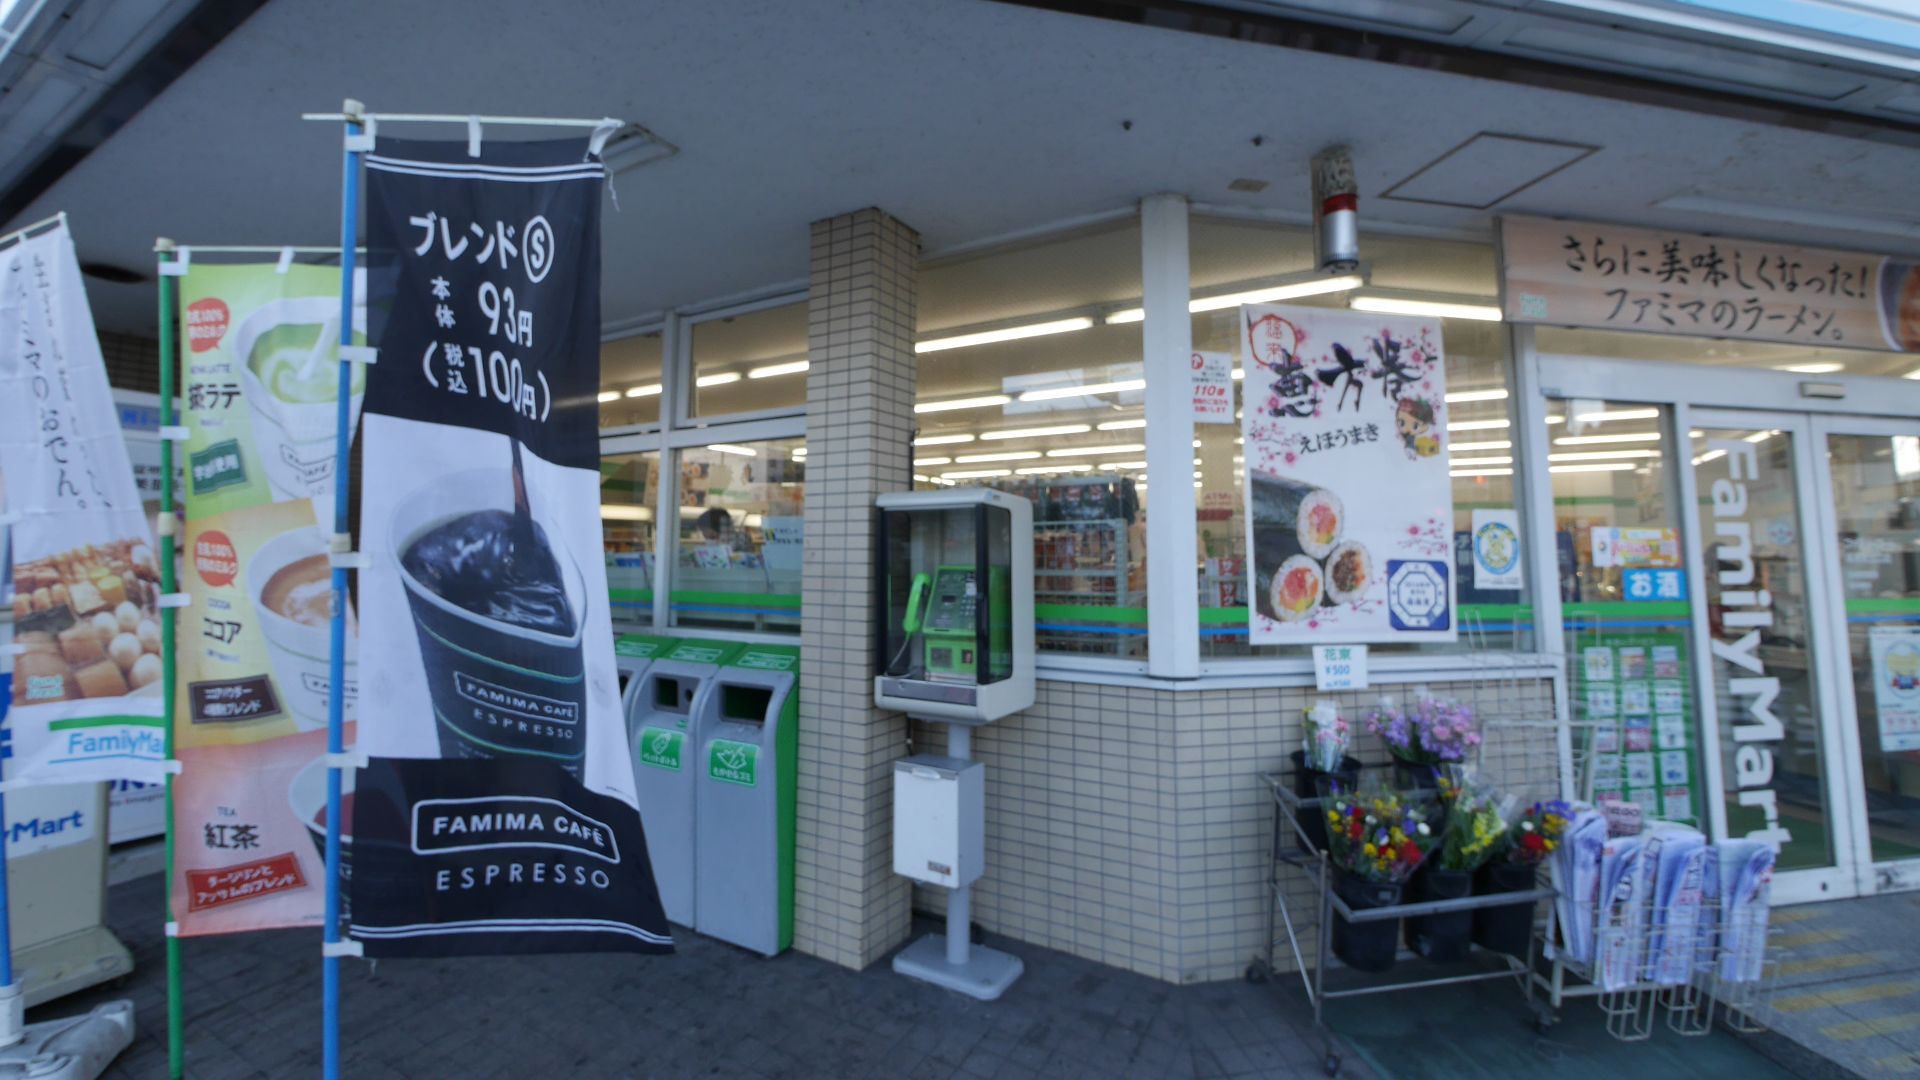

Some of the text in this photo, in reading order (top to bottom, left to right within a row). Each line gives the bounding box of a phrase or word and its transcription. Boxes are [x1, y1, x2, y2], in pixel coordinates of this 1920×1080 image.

[408, 212, 519, 270] ブレンド
[1562, 235, 1869, 299] さらに美味しくなった!
[430, 275, 456, 329] 本体
[478, 281, 533, 347] 93円
[1604, 287, 1844, 341] ファミマのラーメン。
[1300, 422, 1380, 455] えほうまき
[1629, 571, 1681, 599] お酒
[1705, 437, 1793, 855] FamilyMart
[466, 682, 540, 712] FAMIMA
[473, 708, 574, 739] ESPRESSO
[67, 730, 164, 754] FamilyMa
[4, 811, 84, 843] Mart
[204, 821, 260, 849] 紅茶
[432, 812, 606, 848] FAMIMA CAFÉ
[436, 862, 610, 891] ESPRESSO
